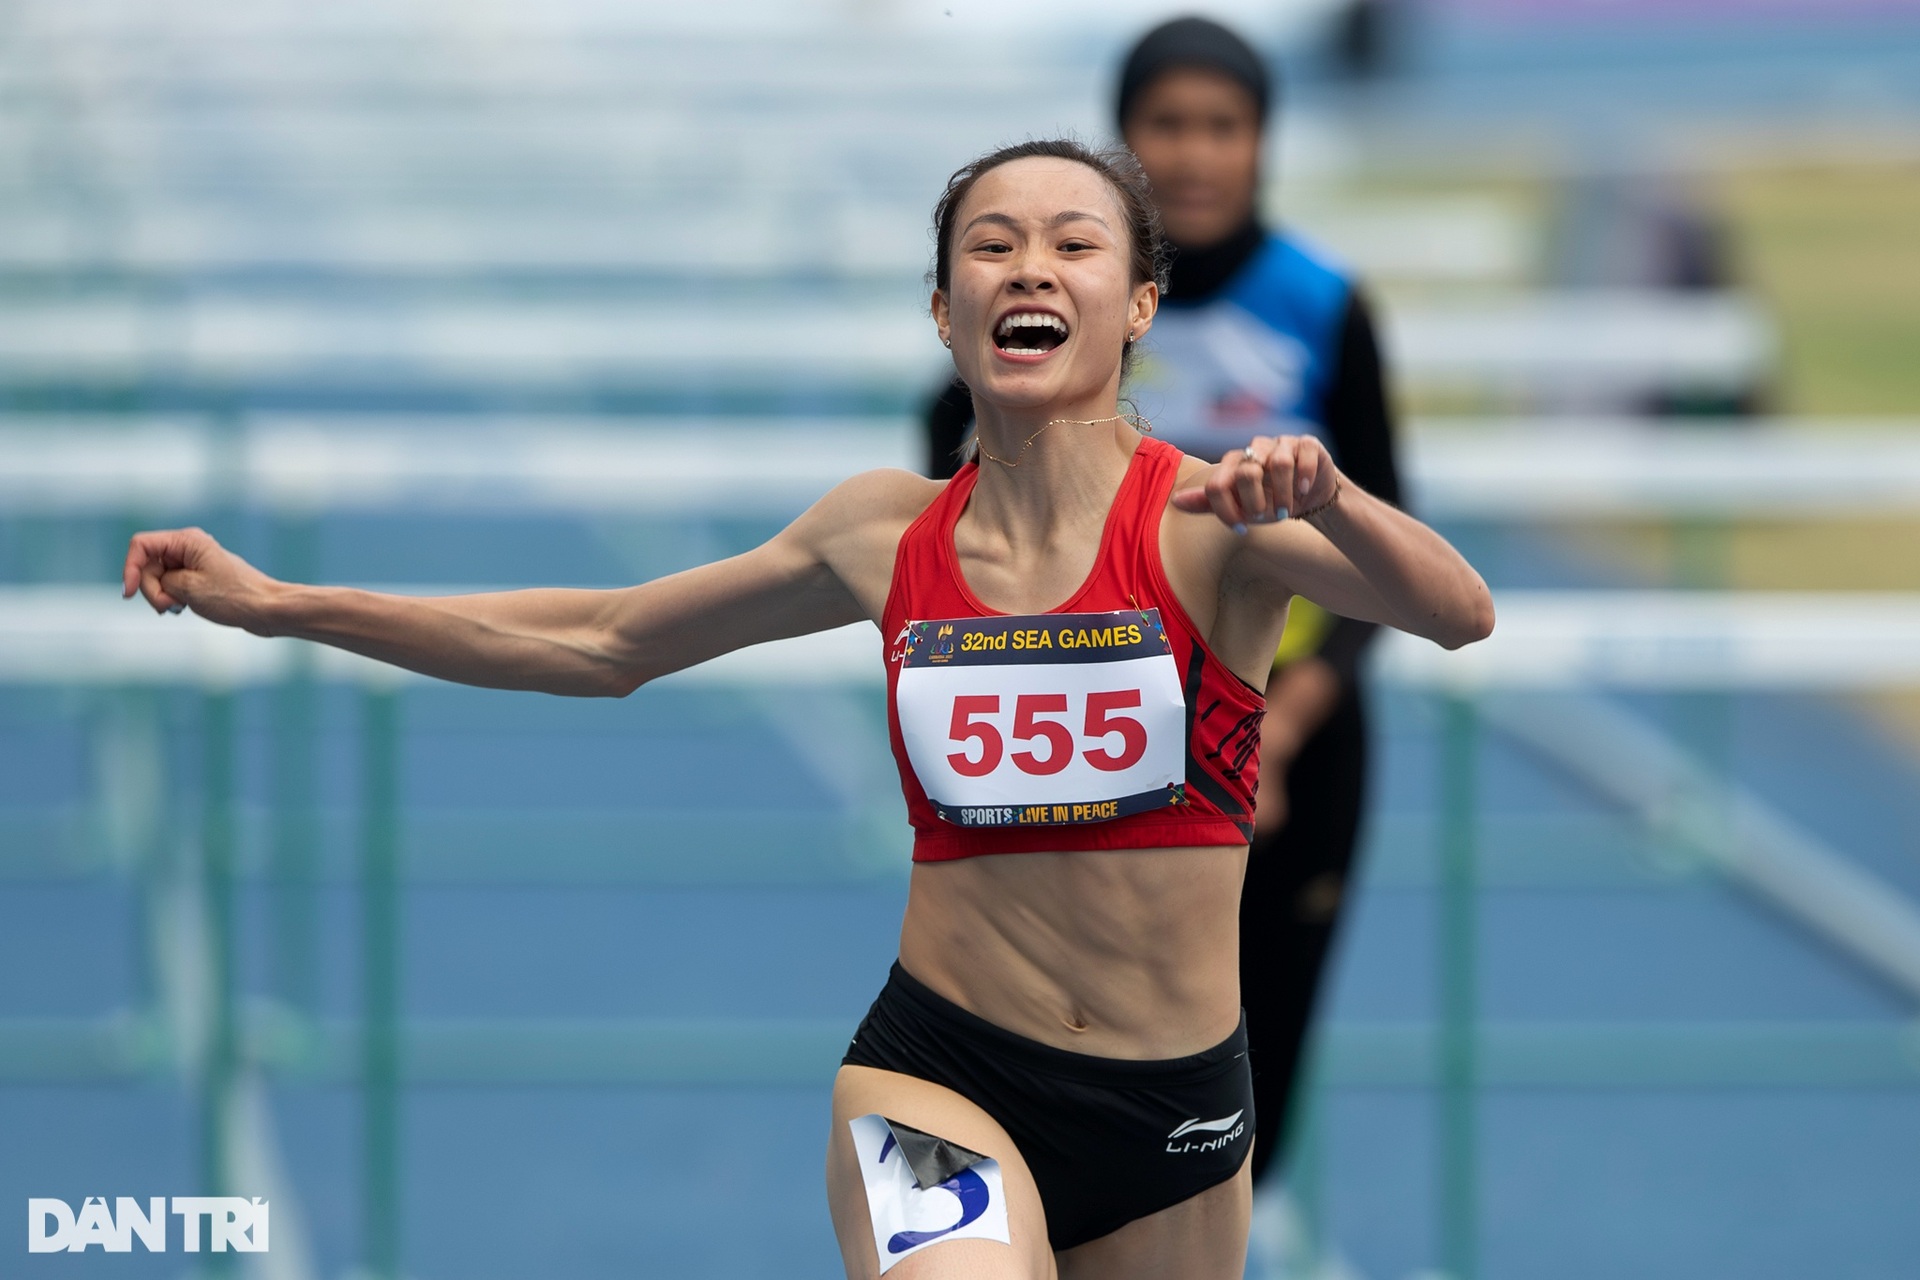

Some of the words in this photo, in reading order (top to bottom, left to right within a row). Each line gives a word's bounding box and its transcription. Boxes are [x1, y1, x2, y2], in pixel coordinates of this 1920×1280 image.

[960, 630, 1008, 651] 32nd
[1011, 629, 1053, 650] SEA
[1058, 623, 1143, 649] GAMES
[946, 688, 1148, 778] 555
[961, 807, 1013, 825] SPORTS
[1017, 805, 1049, 824] LIVE
[1052, 804, 1069, 823] IN
[1072, 800, 1119, 820] PEACE
[1165, 1121, 1245, 1153] LI-NING
